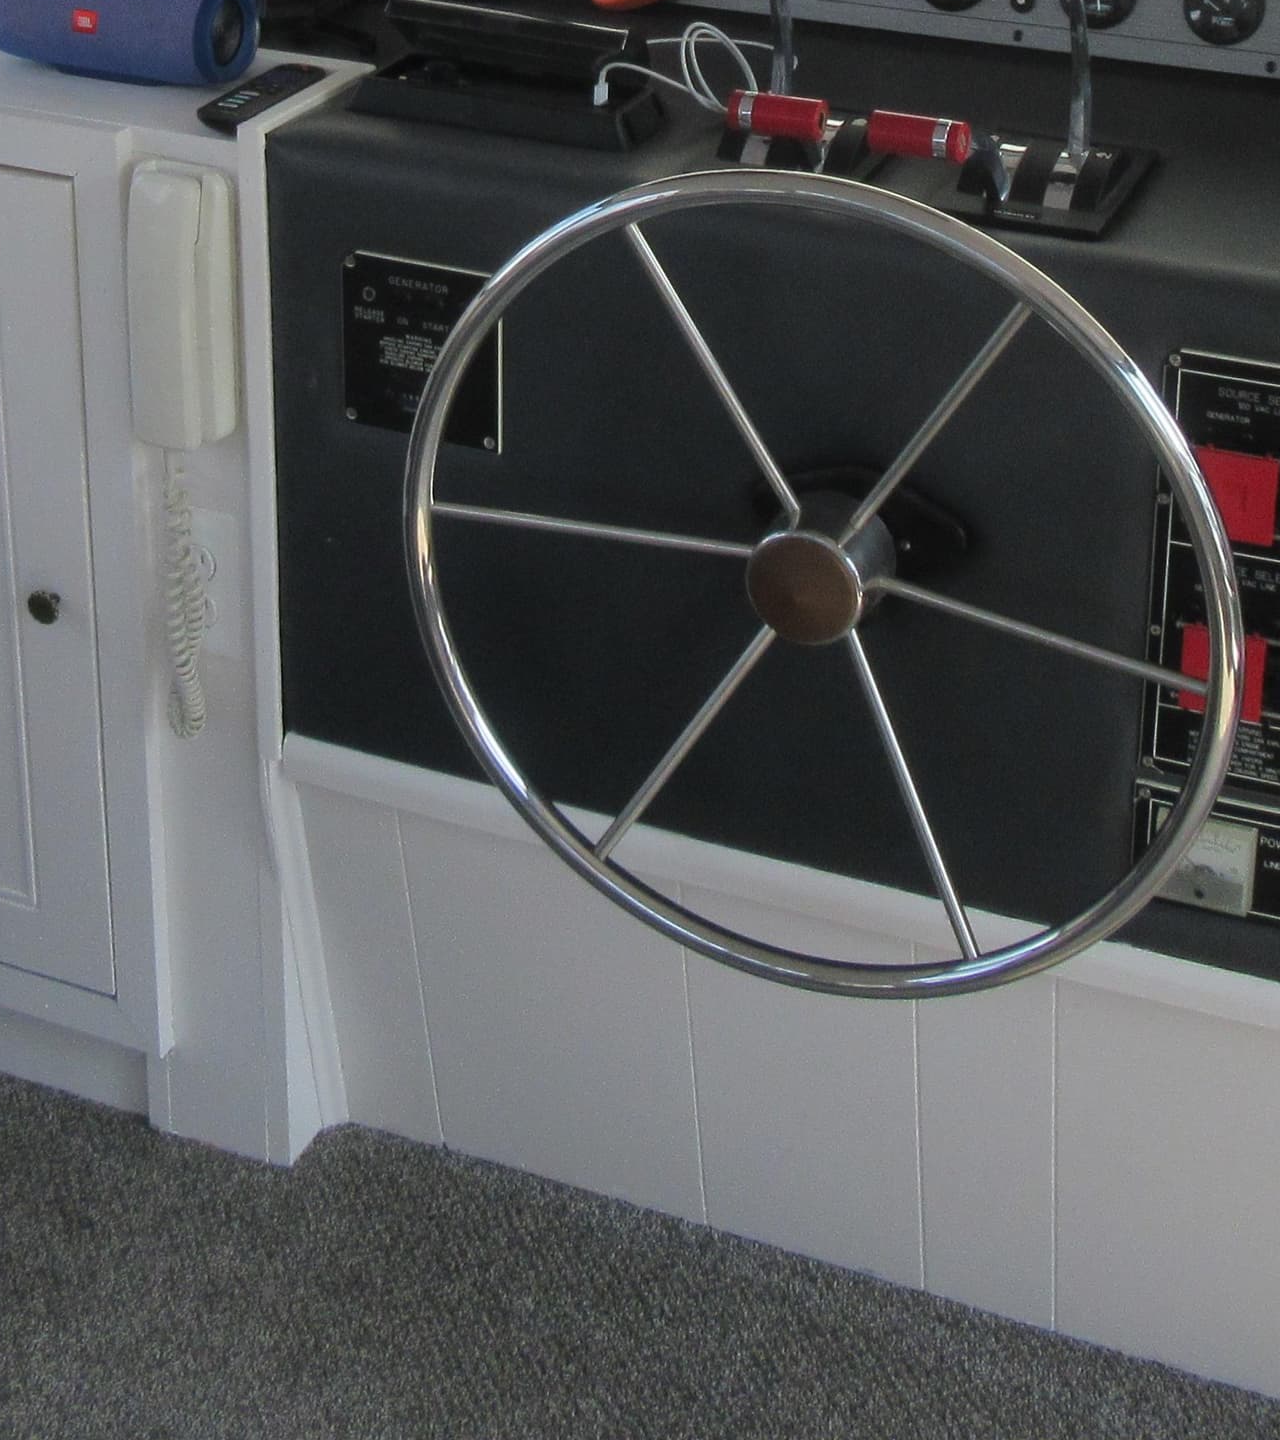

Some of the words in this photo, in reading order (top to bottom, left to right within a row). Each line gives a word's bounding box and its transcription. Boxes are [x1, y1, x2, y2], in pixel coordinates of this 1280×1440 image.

[388, 276, 448, 295] GENERATOR
[1218, 387, 1260, 403] SOURCE
[1206, 411, 1250, 424] GENERATOR
